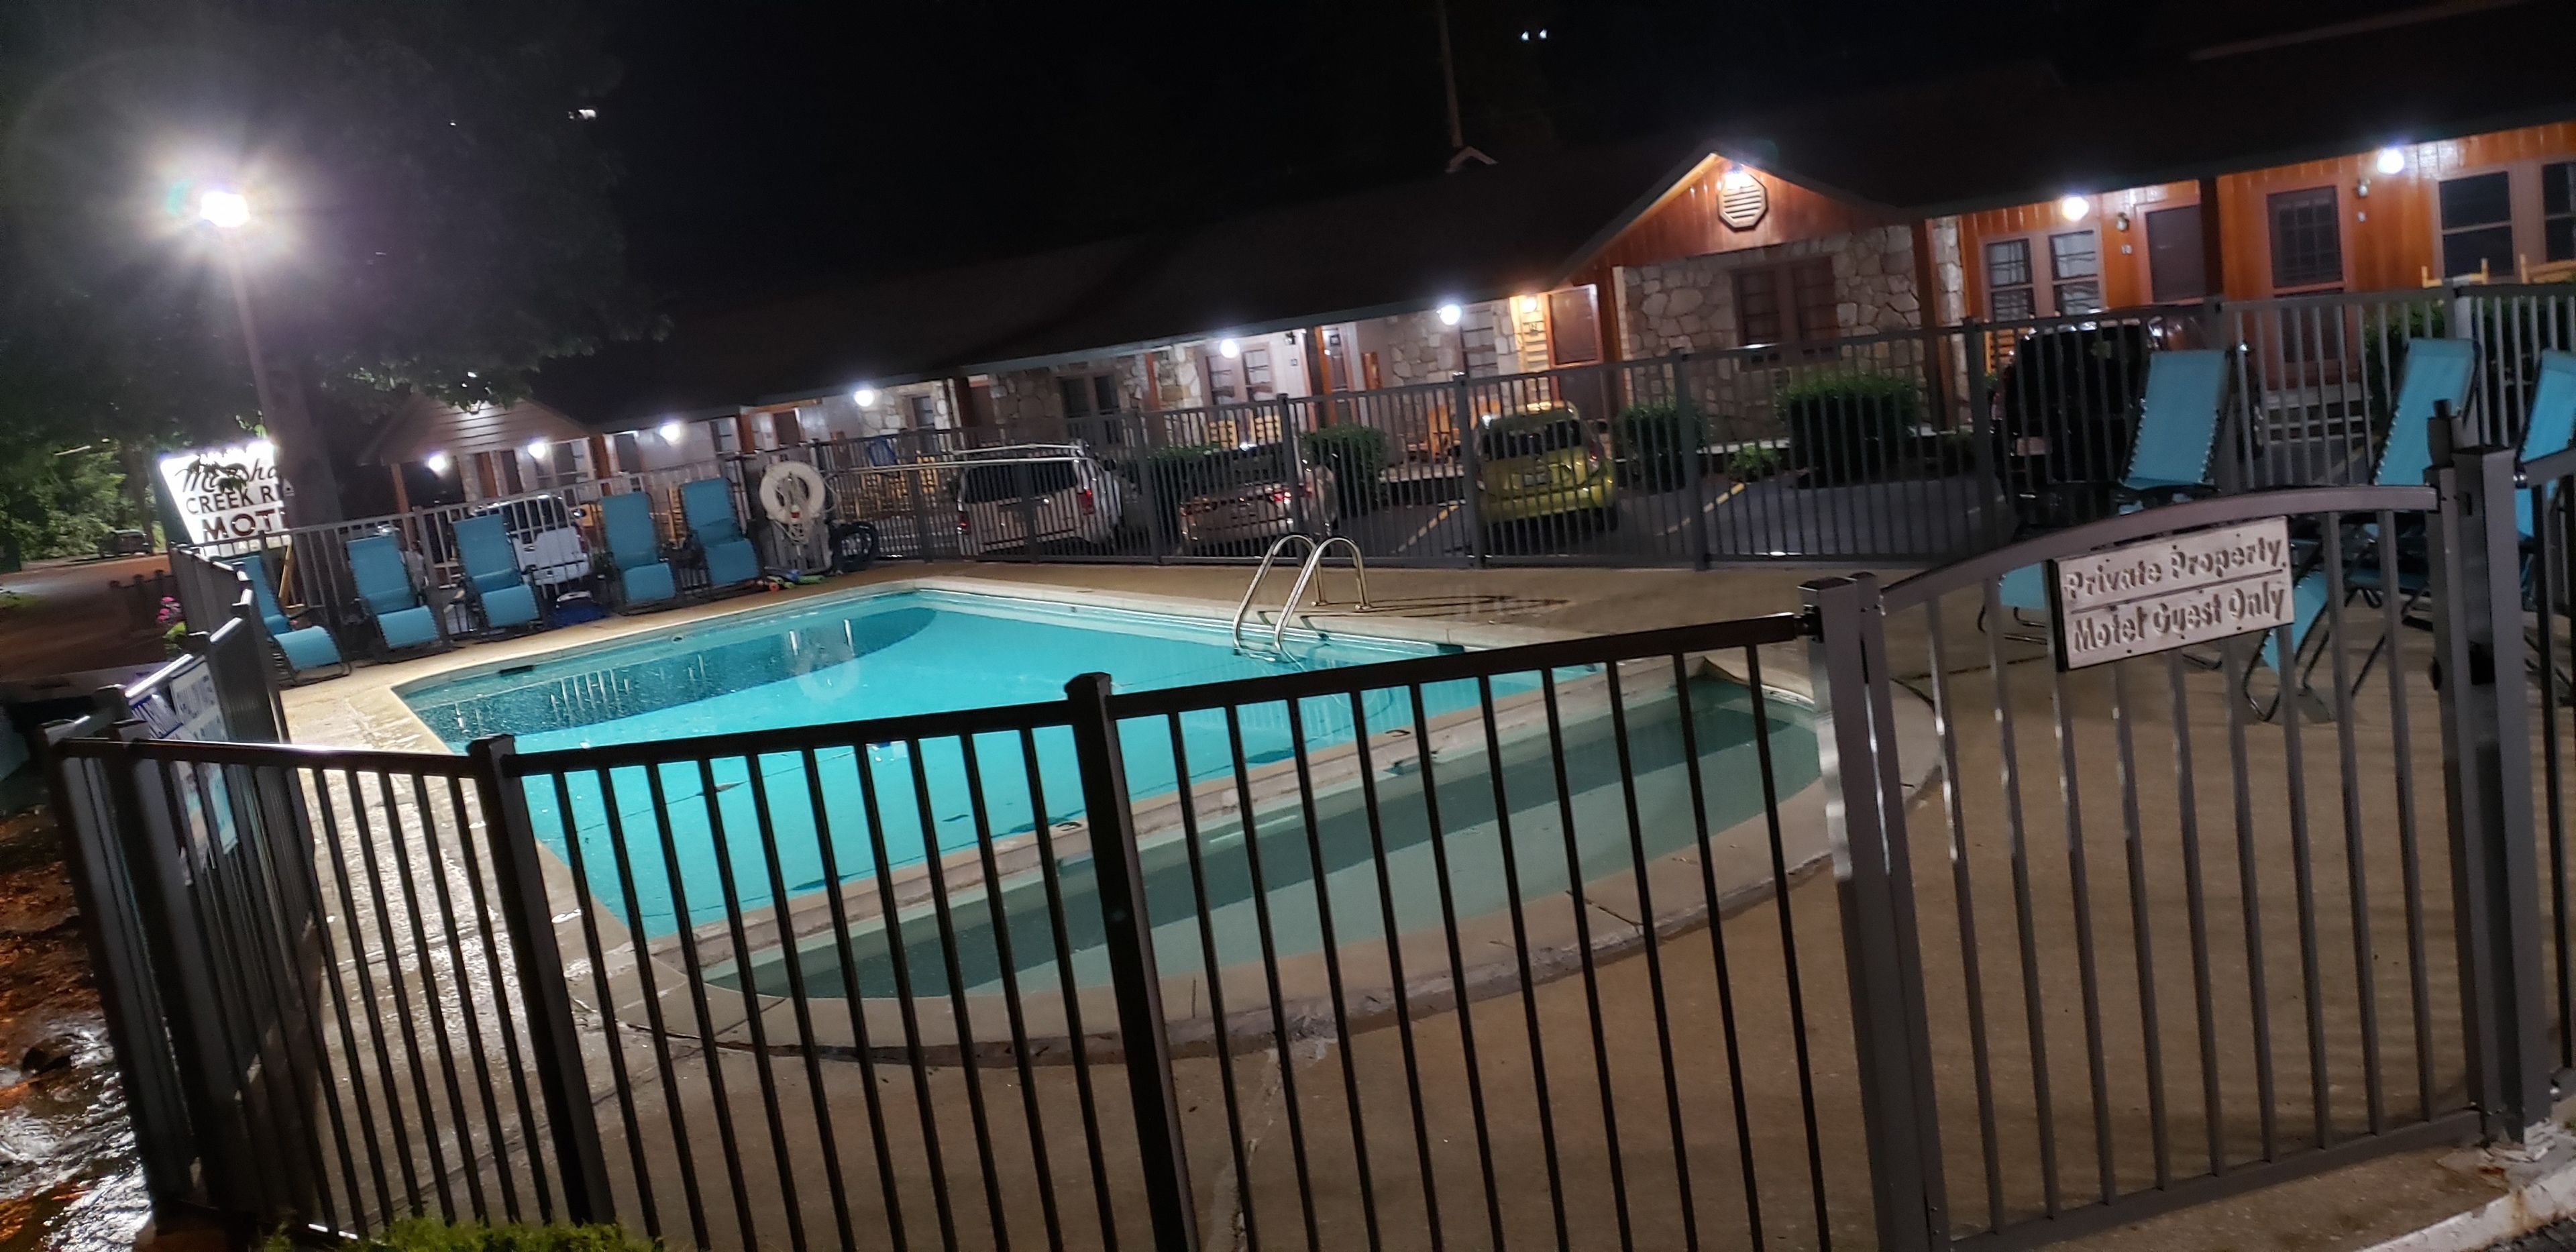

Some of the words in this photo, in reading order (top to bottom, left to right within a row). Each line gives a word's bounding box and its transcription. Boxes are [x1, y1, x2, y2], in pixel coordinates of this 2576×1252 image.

[186, 488, 254, 515] CREEK
[2063, 560, 2162, 600] Private
[2171, 537, 2282, 579] Property
[2074, 606, 2147, 653] Motel
[2153, 594, 2222, 636] Guest
[2229, 581, 2284, 621] Only
